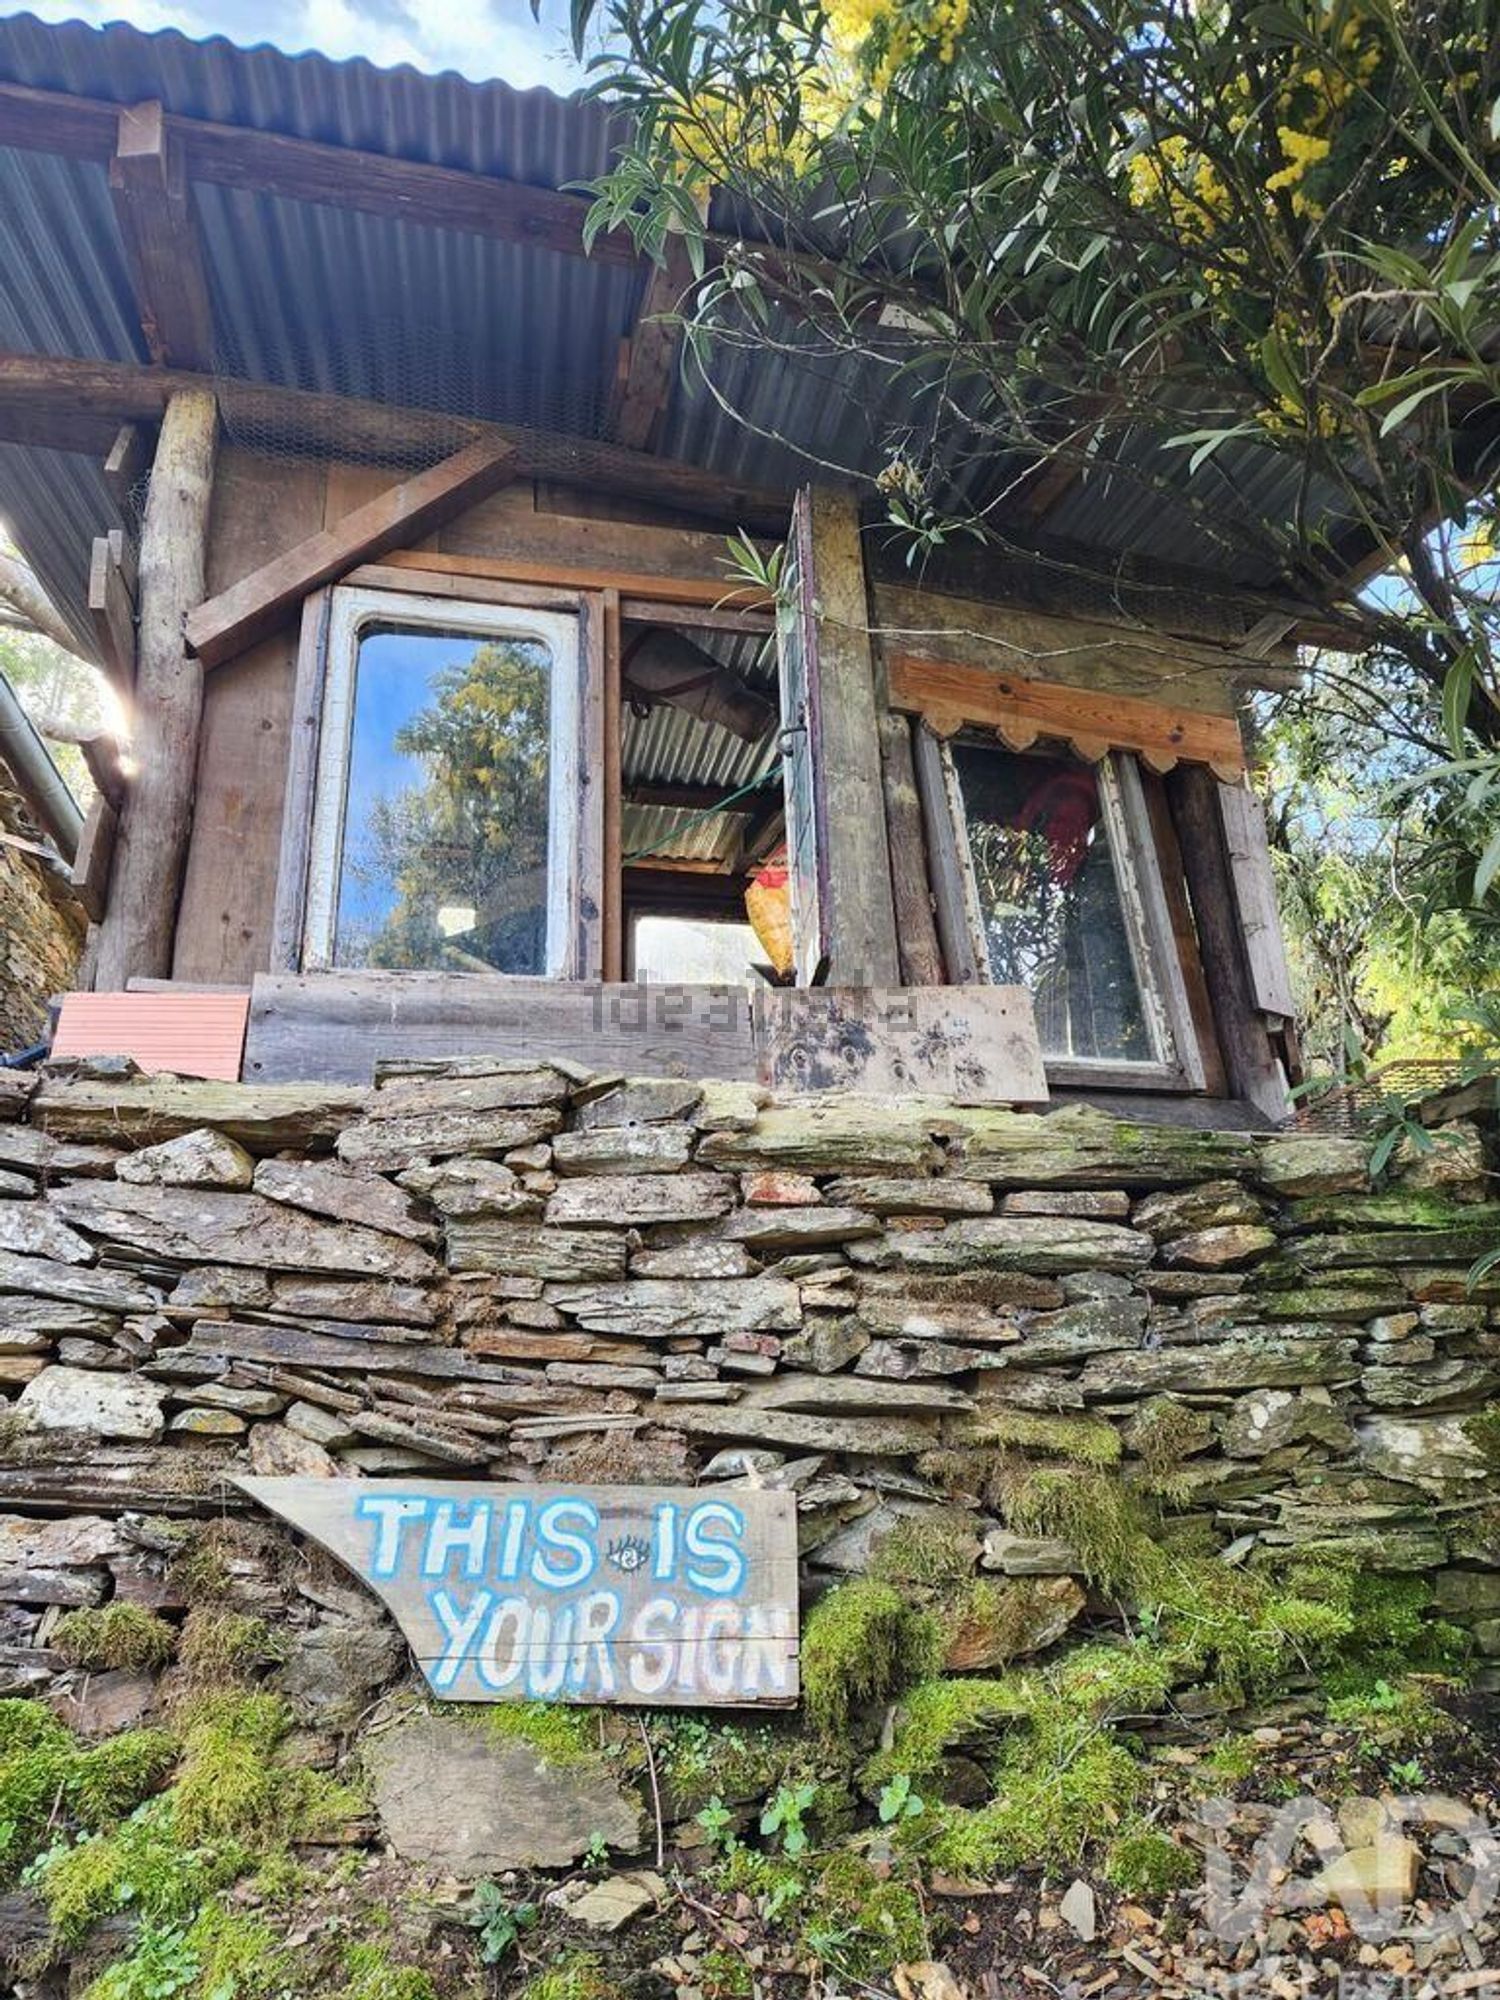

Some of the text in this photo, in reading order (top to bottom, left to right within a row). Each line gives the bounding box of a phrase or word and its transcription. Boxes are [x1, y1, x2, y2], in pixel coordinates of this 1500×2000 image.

[355, 1494, 750, 1599] THIS IS
[430, 1588, 789, 1699] YOUR SIGN
